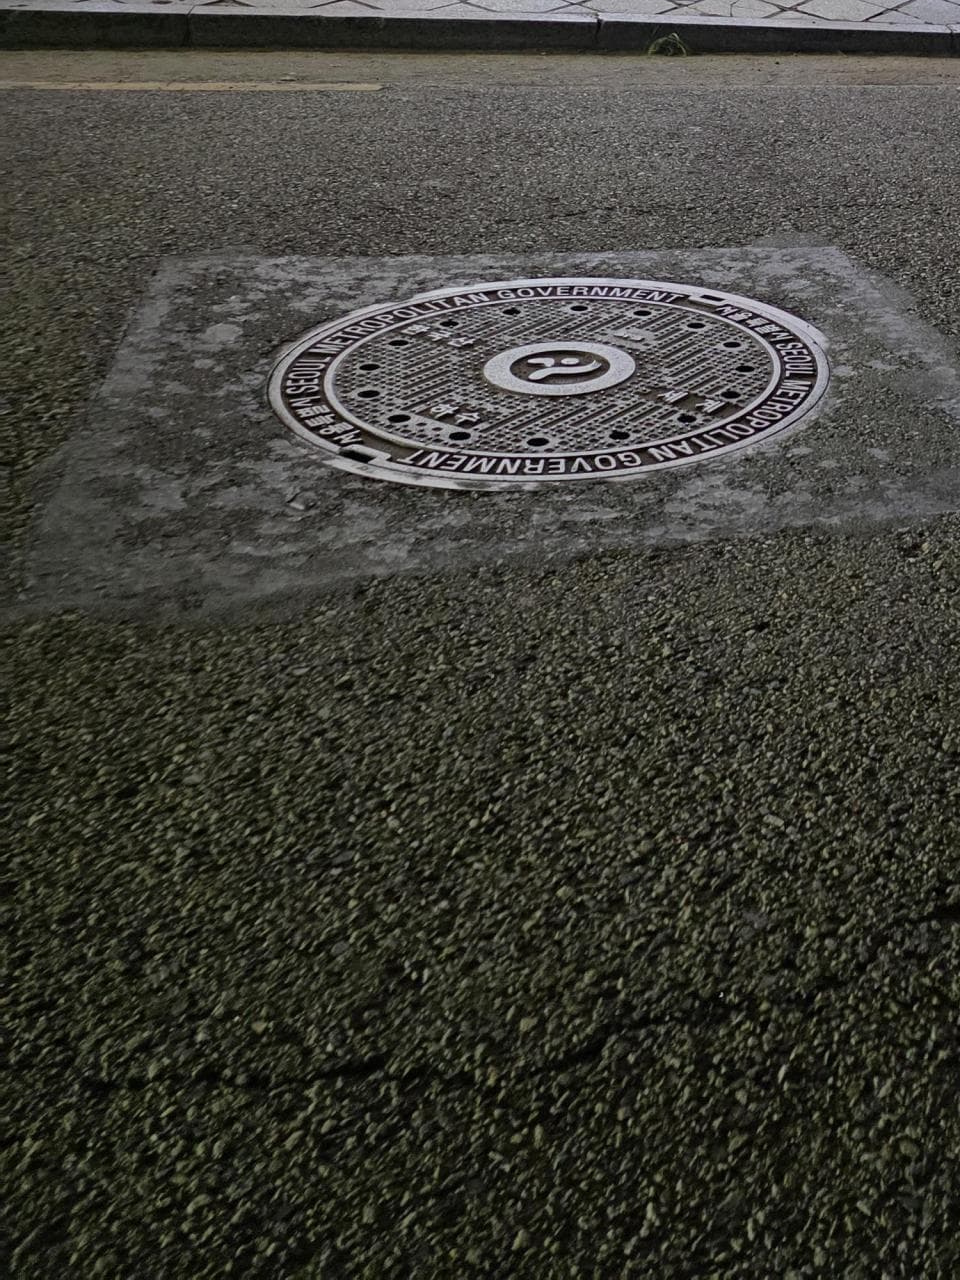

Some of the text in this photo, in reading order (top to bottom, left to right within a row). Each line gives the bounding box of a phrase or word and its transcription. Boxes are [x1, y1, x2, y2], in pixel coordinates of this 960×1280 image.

[286, 286, 685, 447] 서울특별시 SEOUL METROPOLITAN GOVERNMENT
[397, 303, 814, 474] 서울특별시 SEOUL METROPOLITAN GOVERNMENT
[430, 404, 480, 423] 하수
